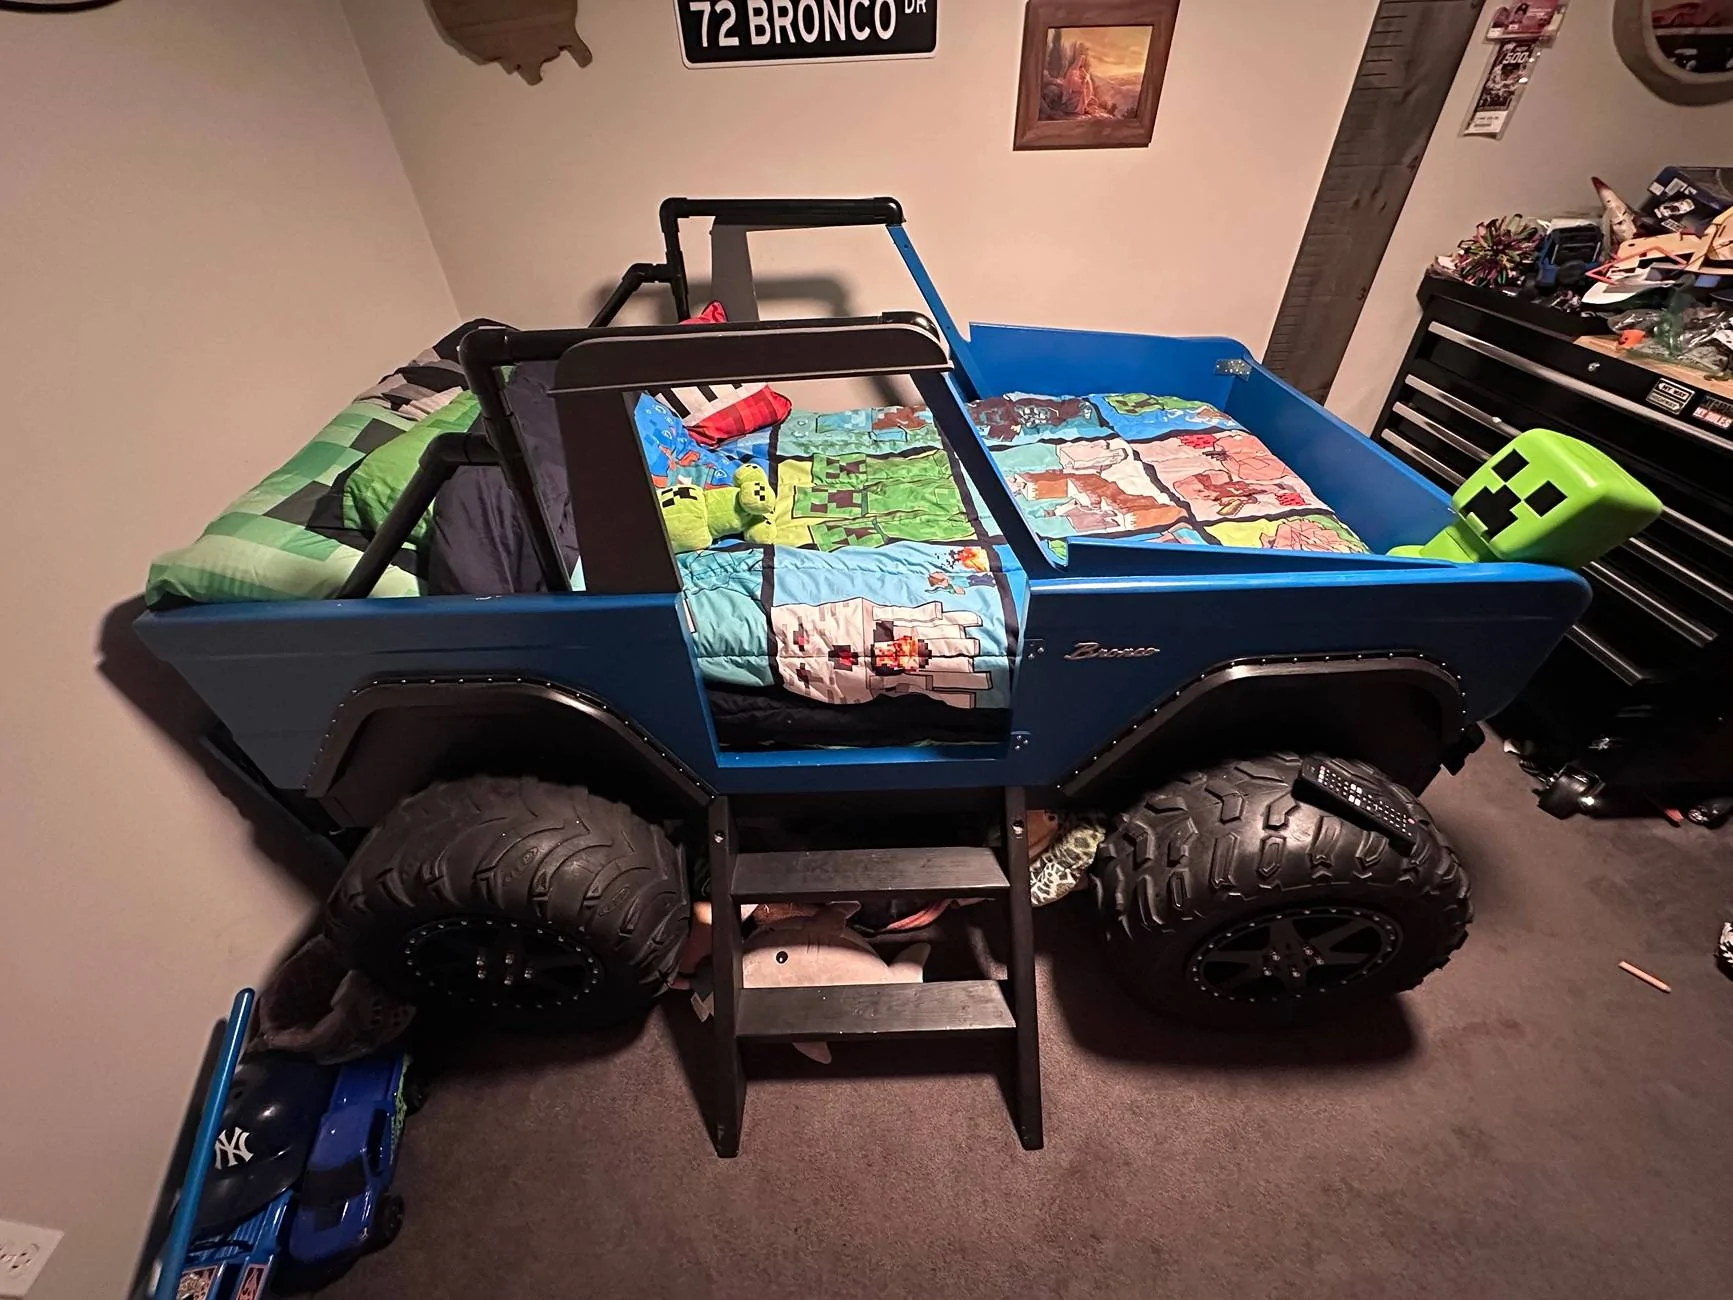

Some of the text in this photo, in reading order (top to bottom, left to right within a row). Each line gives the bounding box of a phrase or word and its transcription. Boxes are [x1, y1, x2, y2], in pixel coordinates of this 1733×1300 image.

[689, 0, 927, 47] 72 BRONCO DR
[1502, 52, 1529, 64] 500
[1064, 642, 1160, 661] Bronco
